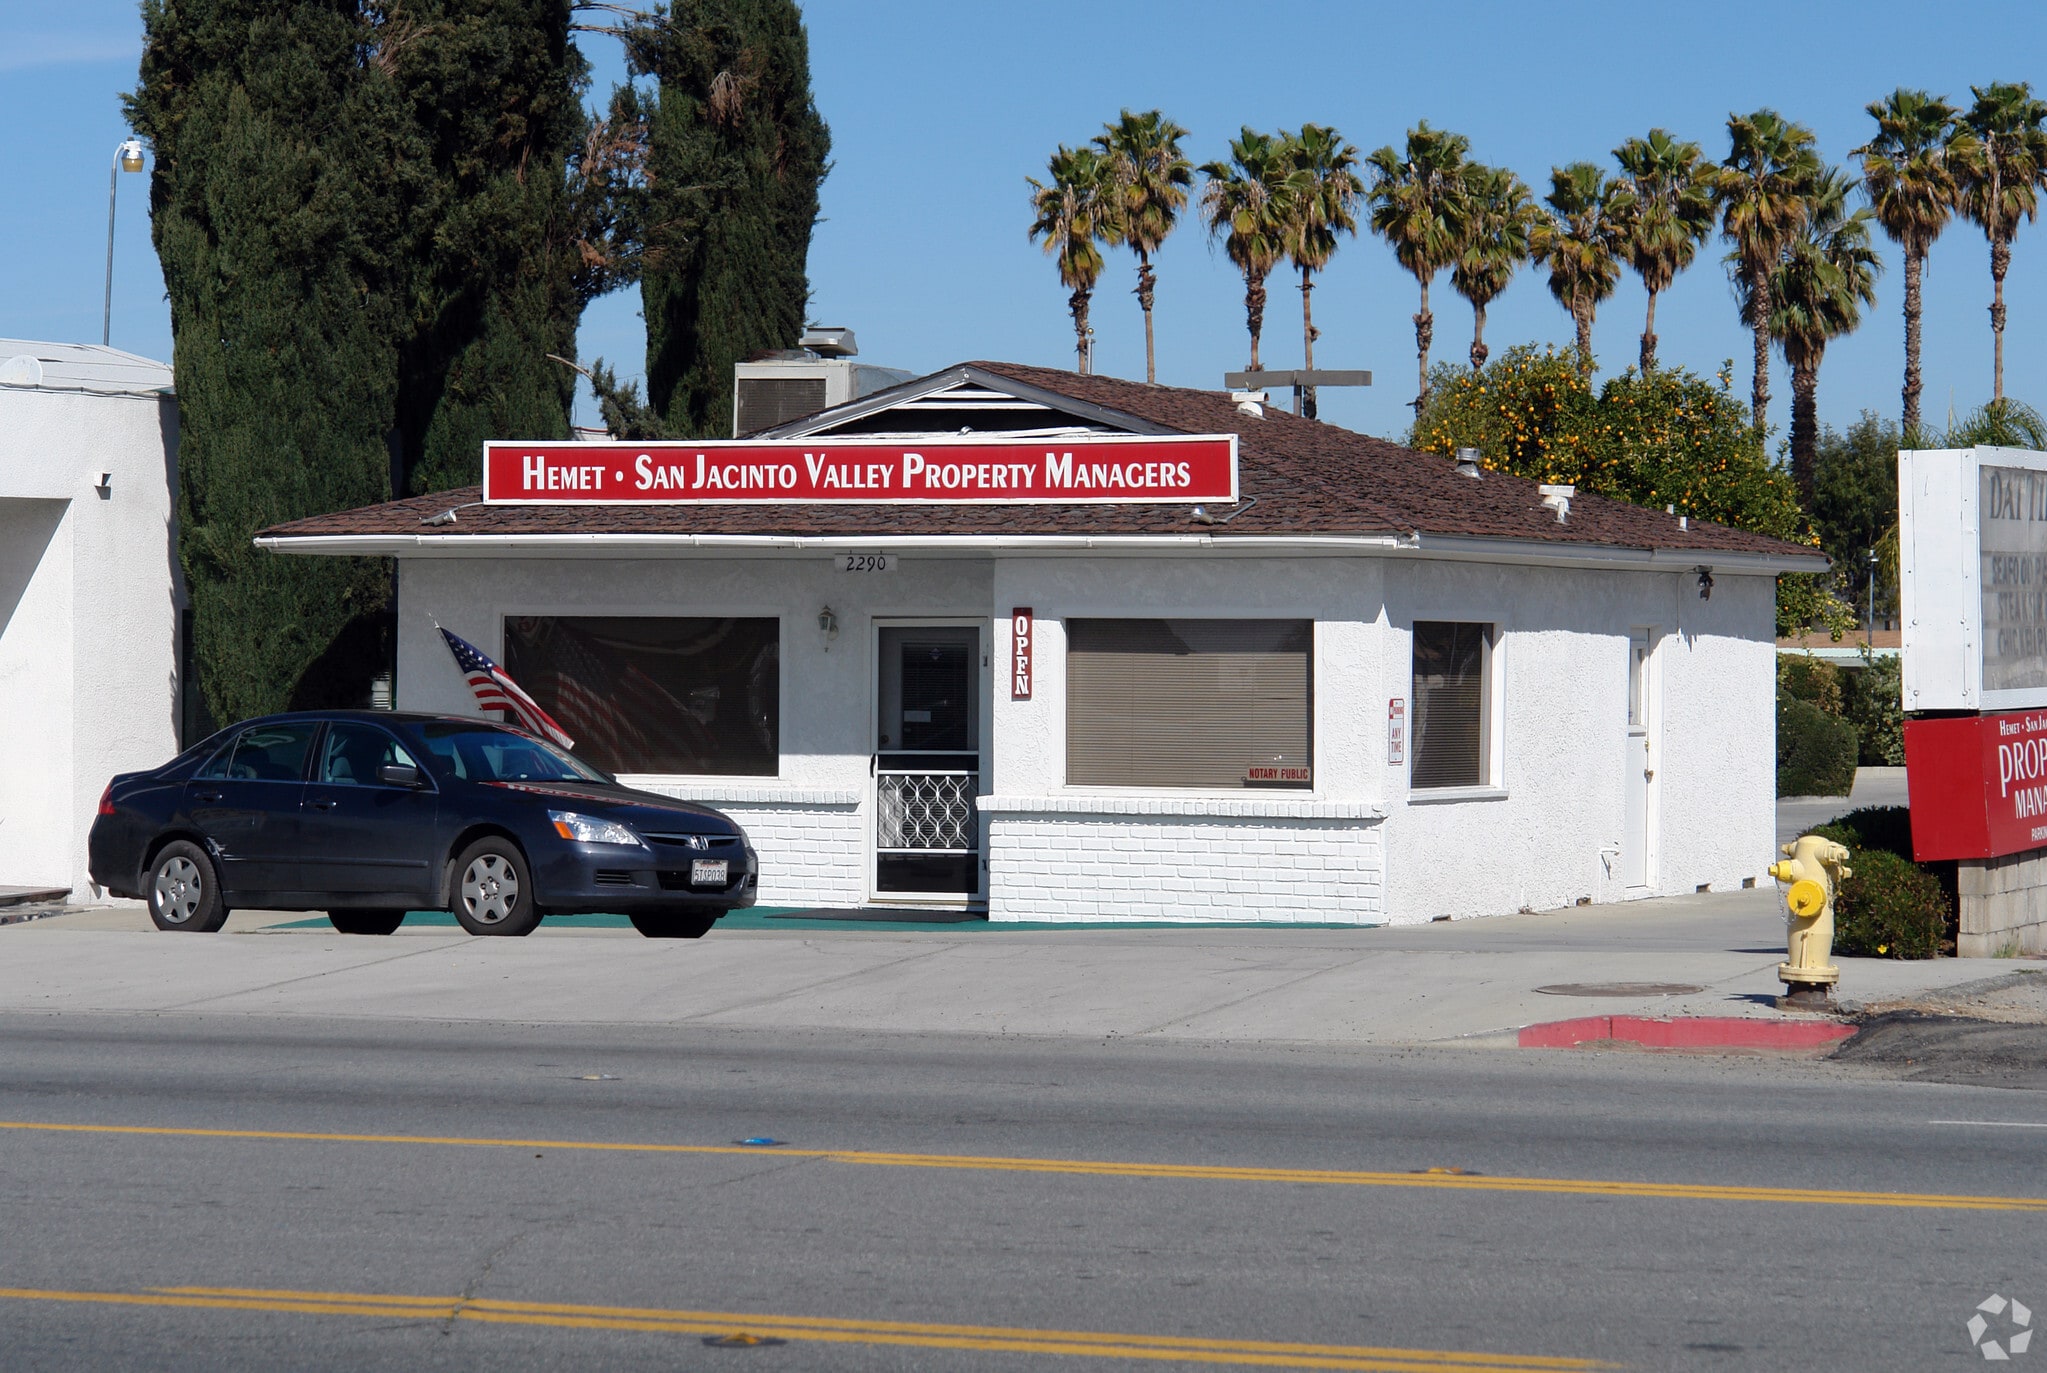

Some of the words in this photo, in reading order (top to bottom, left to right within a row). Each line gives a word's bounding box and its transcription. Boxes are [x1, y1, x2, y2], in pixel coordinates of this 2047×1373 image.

[522, 455, 606, 490] HEMET
[634, 453, 685, 490] SAN
[691, 454, 798, 489] JACINTO
[804, 452, 894, 488] VALLEY
[902, 452, 1037, 489] PROPERTY
[1045, 452, 1191, 488] MANAGERS
[846, 556, 886, 572] 2290
[1015, 616, 1029, 695] OPEN
[1249, 768, 1278, 779] NOTARY
[1281, 768, 1308, 779] PUBLIC
